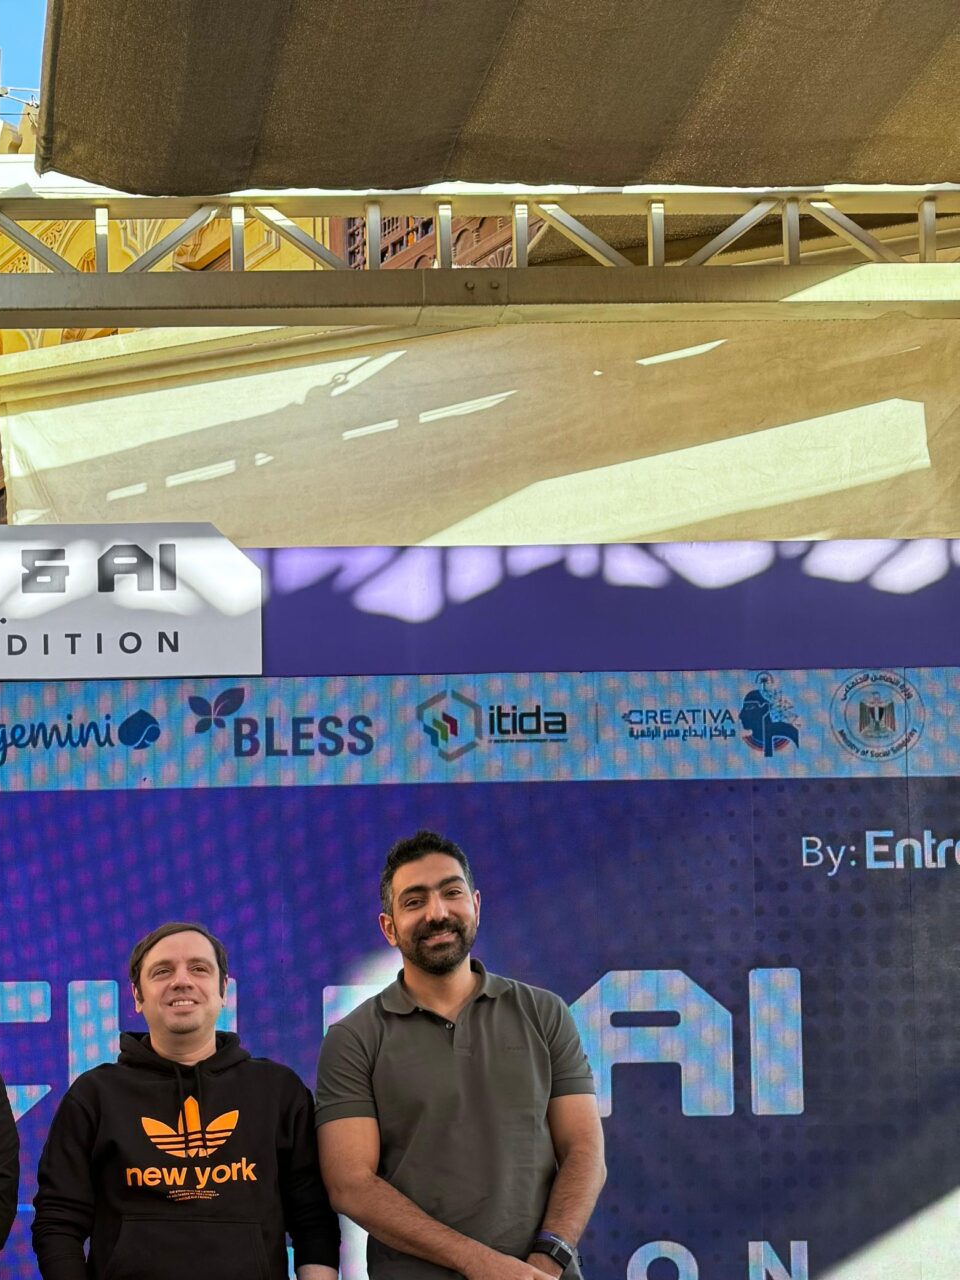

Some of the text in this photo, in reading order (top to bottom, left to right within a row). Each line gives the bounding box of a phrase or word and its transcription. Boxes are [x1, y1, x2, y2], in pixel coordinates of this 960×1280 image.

[21, 548, 69, 594] &
[97, 543, 177, 593] AI
[488, 705, 567, 735] itida
[623, 709, 735, 725] CREATIVA
[234, 715, 374, 757] BLESS
[802, 836, 856, 876] By:
[126, 1157, 257, 1190] new york
